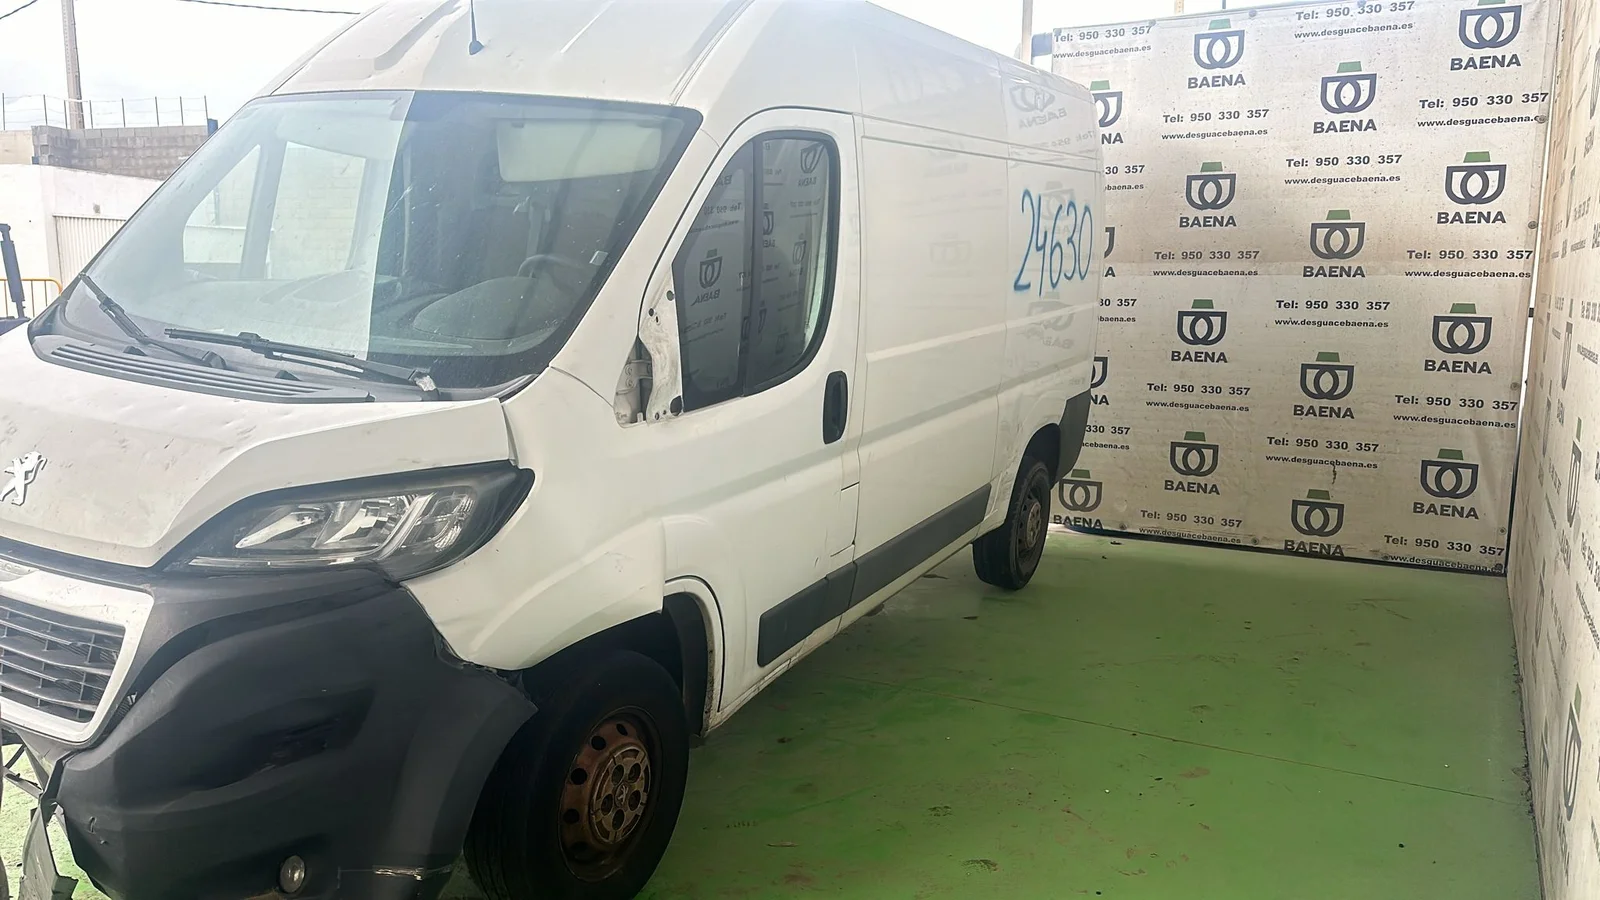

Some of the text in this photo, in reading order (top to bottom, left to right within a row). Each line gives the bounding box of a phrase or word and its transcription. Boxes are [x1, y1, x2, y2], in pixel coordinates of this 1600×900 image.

[1296, 1, 1415, 21] Tel: 950 330 357
[1054, 26, 1152, 42] Tel: 950 330 357
[1294, 22, 1413, 38] www.desguacebaena.es
[1053, 45, 1151, 58] www.desguacebaena.es
[1450, 54, 1521, 71] BAENA
[1188, 74, 1246, 89] BAENA
[1420, 92, 1549, 109] Tel: 950 330 357
[1163, 109, 1269, 123] Tel: 950 330 357
[1417, 115, 1541, 128] www.desguacebaena.e
[1313, 119, 1377, 134] BAENA
[1162, 129, 1268, 140] www.desguacebaena.es
[1286, 154, 1402, 168] Tel: 950 330 357
[1105, 164, 1145, 175] 30 357
[1284, 175, 1400, 186] www.desguacebaena.es
[1179, 216, 1236, 228] BAENA
[1437, 211, 1506, 224] BAENA
[1014, 188, 1092, 296] 24630
[1154, 251, 1259, 260] Tel: 950 330 357
[1407, 250, 1533, 260] Tel: 950 330 357
[1153, 269, 1258, 277] www.desguacebaena.es
[1303, 266, 1365, 278] BAENA
[1405, 270, 1531, 279] www.desguacebaena.es
[1100, 298, 1137, 307] 30 357
[1276, 300, 1390, 311] Tel: 950 330 357
[1275, 319, 1389, 328] www.desguacebaena.es
[1171, 351, 1228, 363] BAENA
[1424, 359, 1492, 374] BAENA
[1147, 383, 1250, 396] Tel: 950 330 357
[1146, 400, 1249, 411] www.desguacebaena.es
[1395, 395, 1518, 411] Tel: 950 330 357
[1293, 404, 1354, 419] BAENA
[1393, 413, 1516, 429] www.desguacebaena.es
[1086, 425, 1130, 435] 330 357
[1267, 437, 1379, 452] Tel: 950 330 357
[1266, 454, 1378, 469] www.desguacebaena.es
[1164, 480, 1220, 495] BAENA
[1412, 502, 1479, 519] BAENA
[1054, 515, 1103, 530] BAENA
[1140, 510, 1242, 528] Tel: 950 330 357
[1284, 540, 1344, 556] BAENA
[1384, 535, 1505, 556] Tel: 950 330 357
